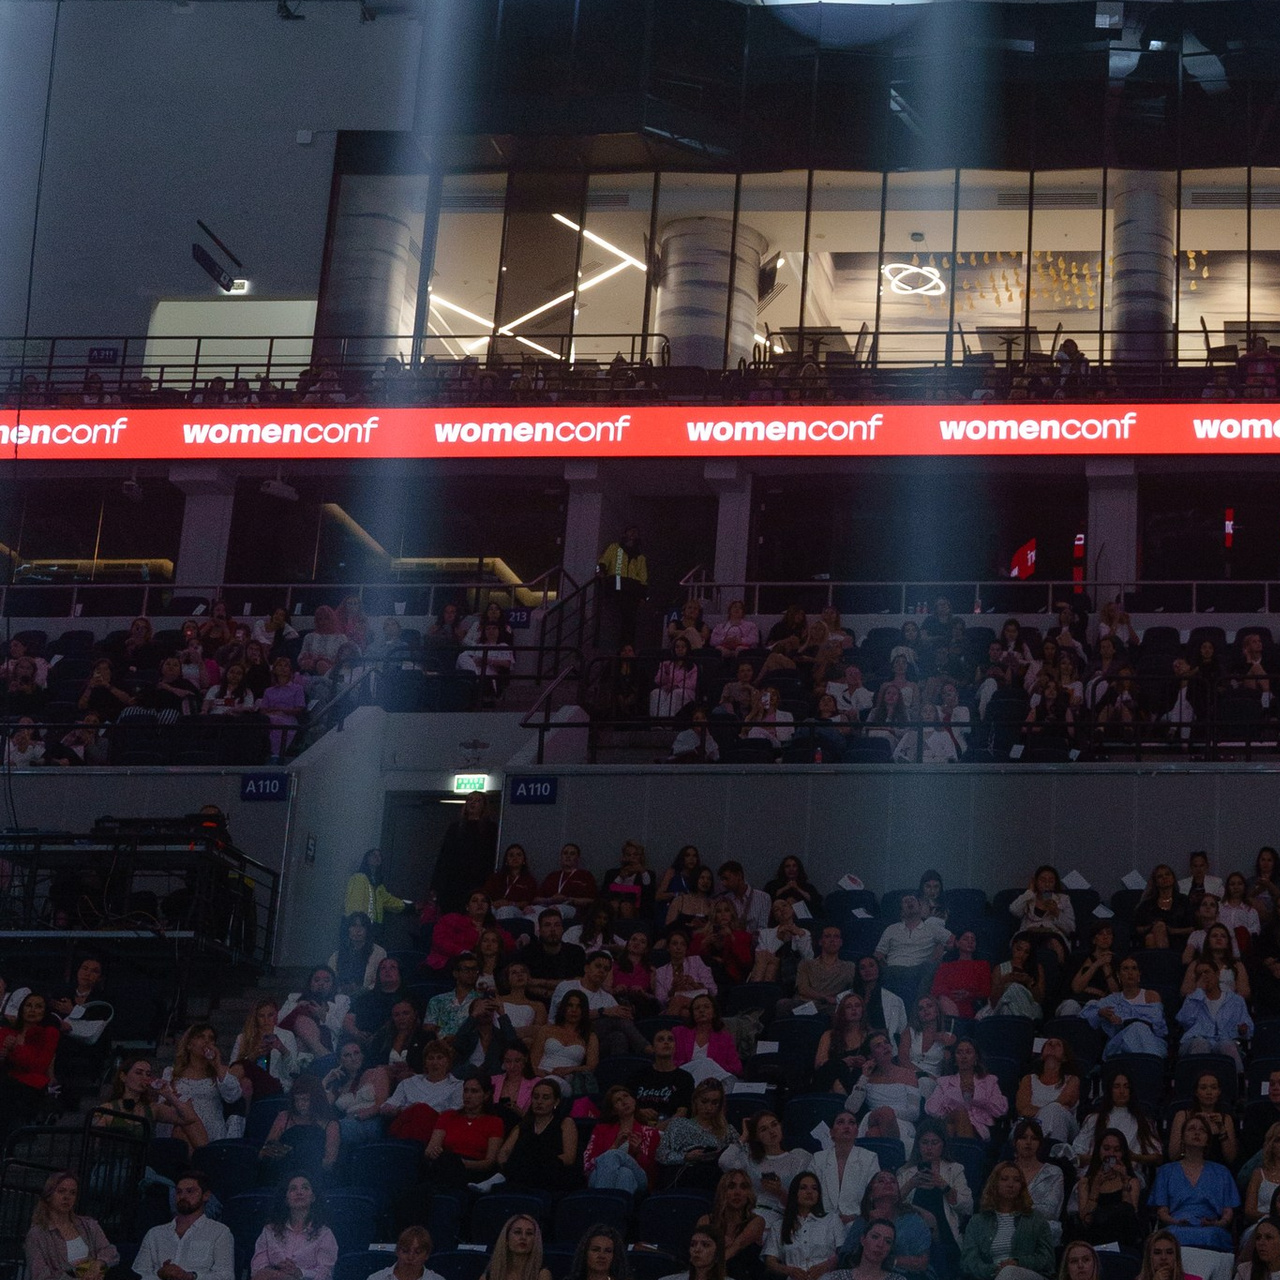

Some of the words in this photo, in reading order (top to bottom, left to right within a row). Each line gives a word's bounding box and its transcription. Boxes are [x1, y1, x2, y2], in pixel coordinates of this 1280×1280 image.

[183, 416, 380, 444] womenconf
[434, 415, 631, 443] womenconf
[686, 413, 883, 442] womenconf
[939, 412, 1137, 440] womenconf
